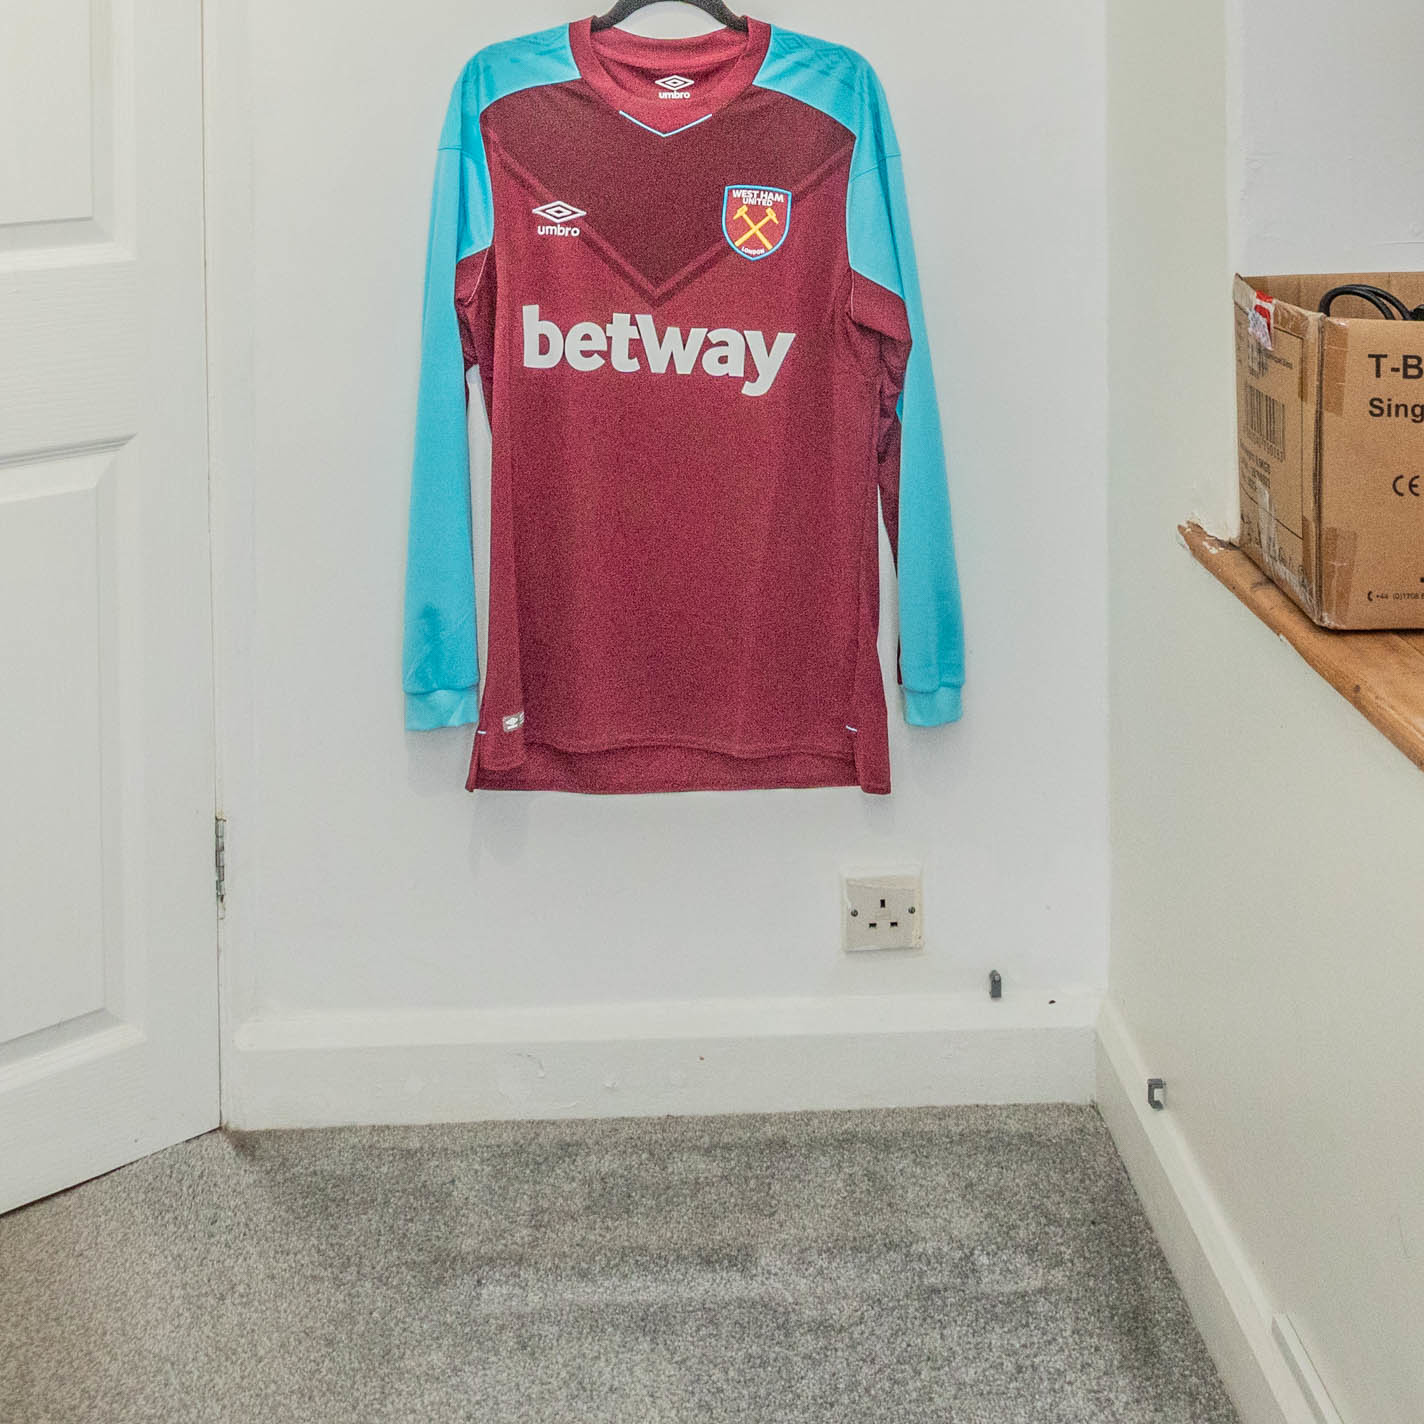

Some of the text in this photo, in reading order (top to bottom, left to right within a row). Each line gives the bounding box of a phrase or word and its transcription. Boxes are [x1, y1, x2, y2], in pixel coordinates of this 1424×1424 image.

[659, 90, 690, 99] umbro
[732, 189, 784, 203] WEST HAM
[742, 197, 773, 206] UNITED
[537, 224, 580, 237] umbro
[741, 246, 765, 255] LONDON
[522, 304, 795, 396] betway
